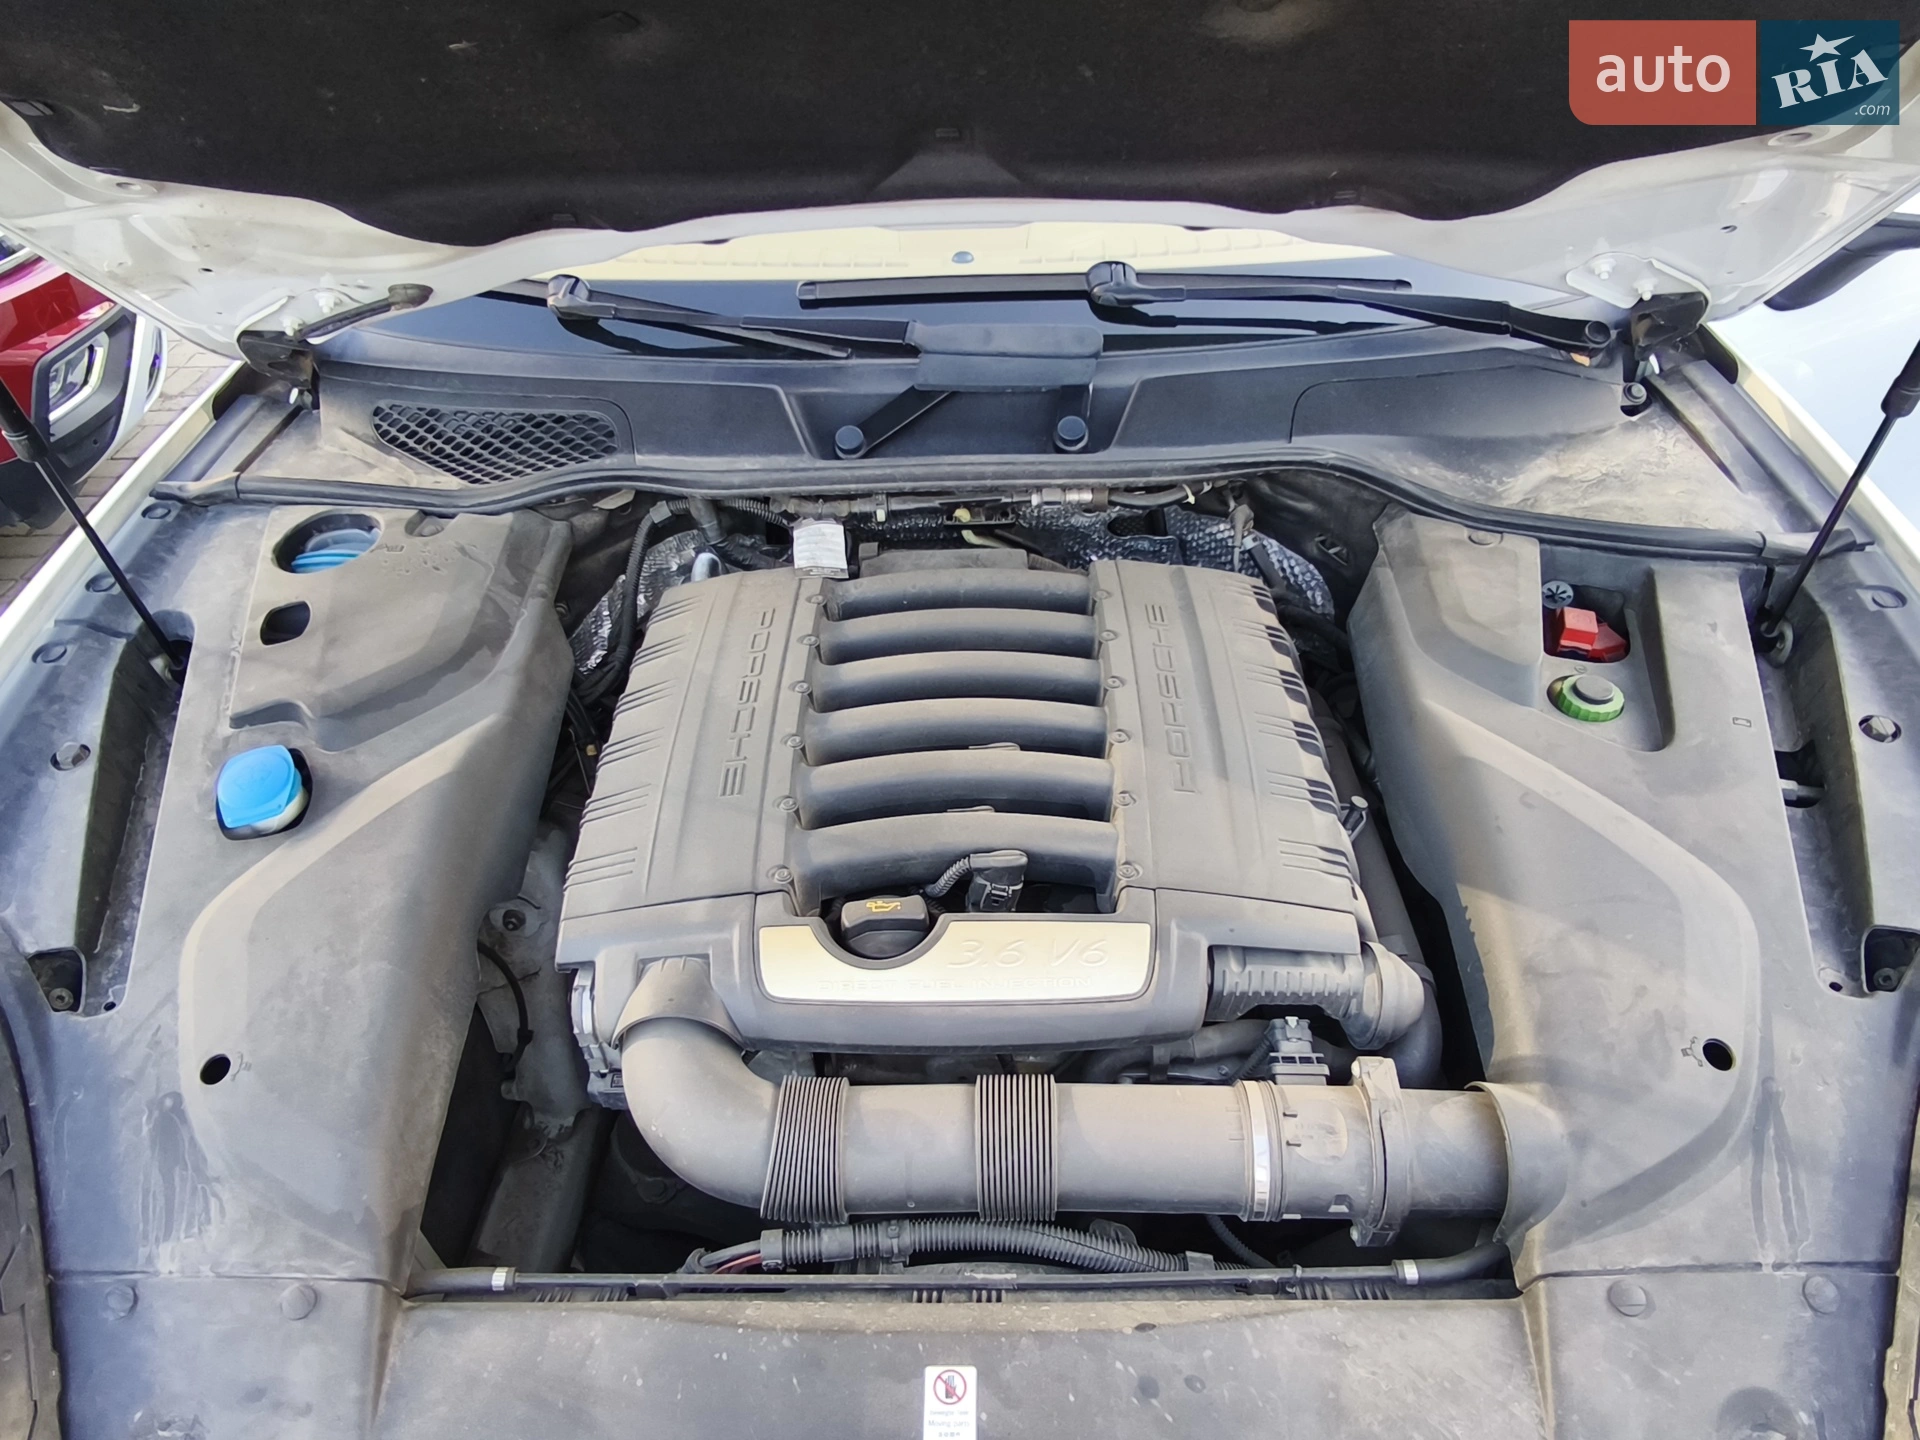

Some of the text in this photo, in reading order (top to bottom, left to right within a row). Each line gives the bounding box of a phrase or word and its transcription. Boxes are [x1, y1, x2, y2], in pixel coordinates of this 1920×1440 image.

[719, 608, 776, 797] PORSCHE
[1145, 603, 1197, 794] PORSCHE
[817, 976, 1094, 993] DIRECT FUEL INJECTION
[947, 938, 1111, 968] 3.6 V6
